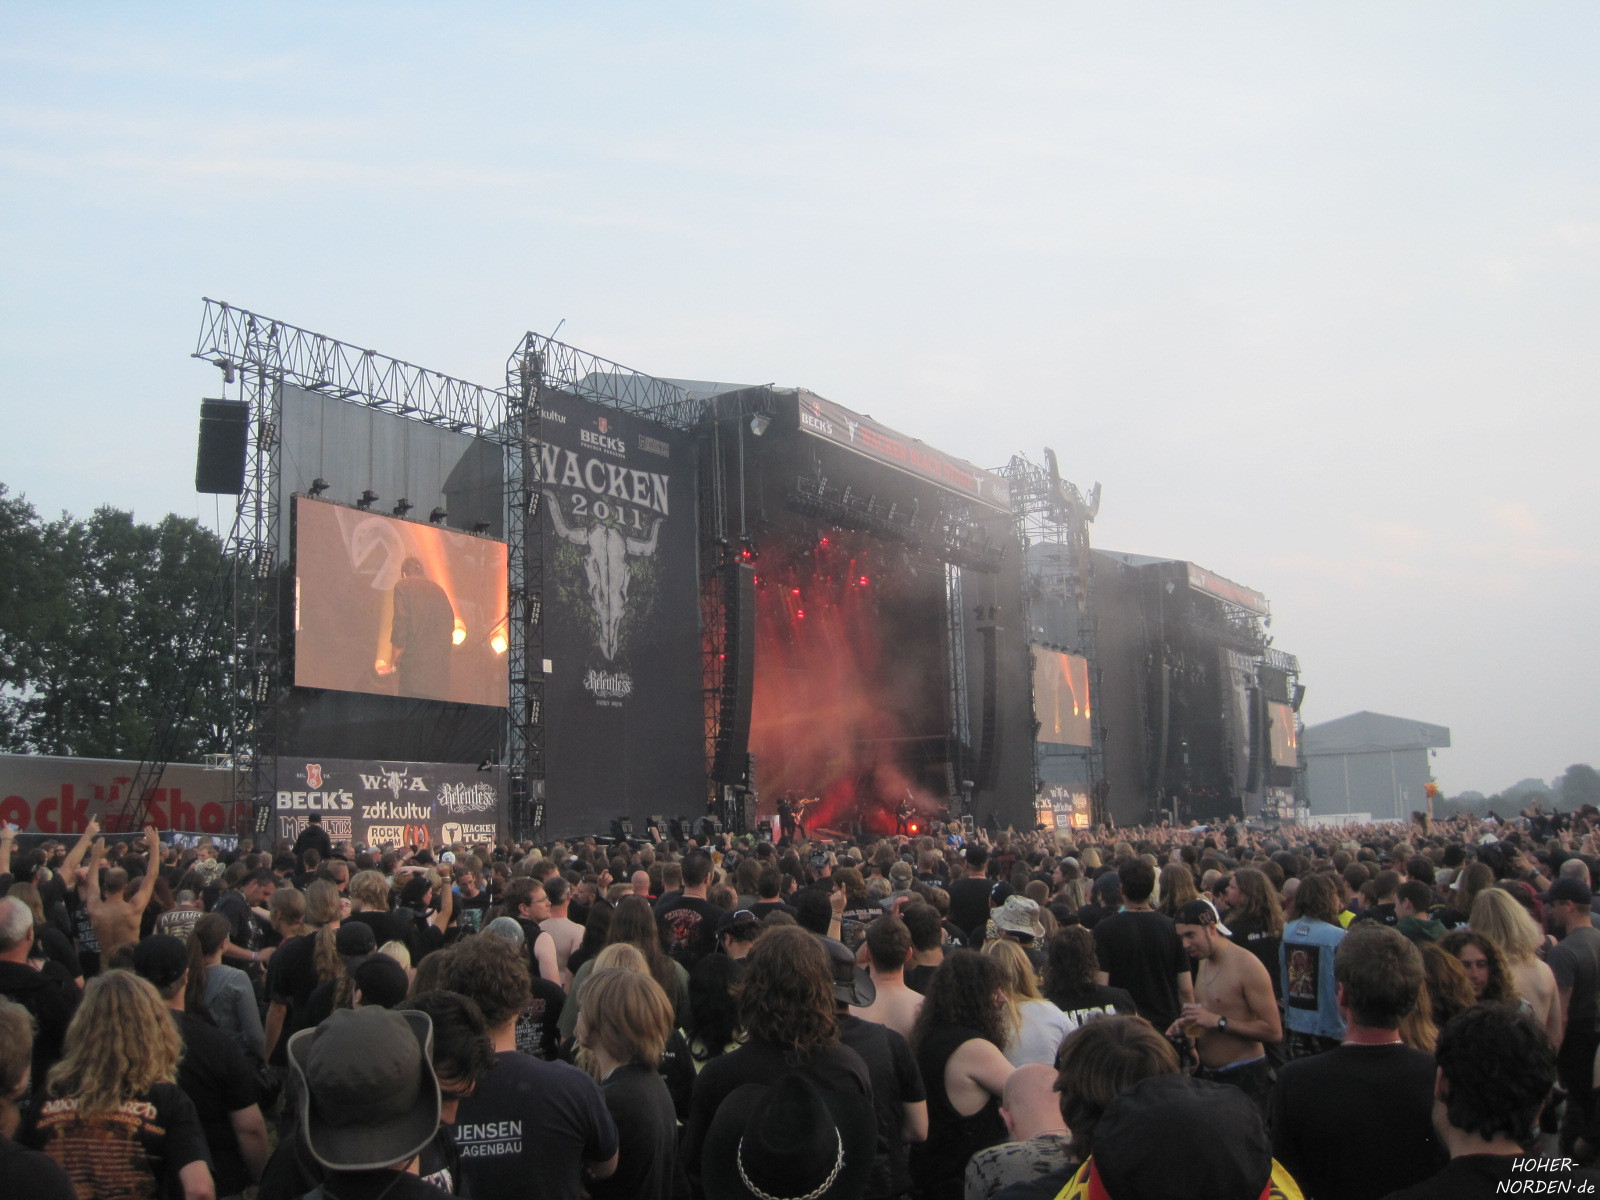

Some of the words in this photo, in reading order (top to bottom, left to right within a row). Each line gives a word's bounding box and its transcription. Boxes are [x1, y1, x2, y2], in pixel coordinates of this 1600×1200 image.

[801, 412, 833, 434] BECK'S
[580, 428, 626, 453] BECK'S
[527, 437, 670, 517] WACKEN
[571, 493, 642, 530] 2011
[276, 788, 354, 810] BECK'S
[361, 801, 432, 819] zdf.kultur
[371, 827, 401, 837] ROCK
[462, 824, 496, 833] WACKEN
[454, 1120, 522, 1140] JENSEN
[460, 1141, 522, 1157] AGENBAU
